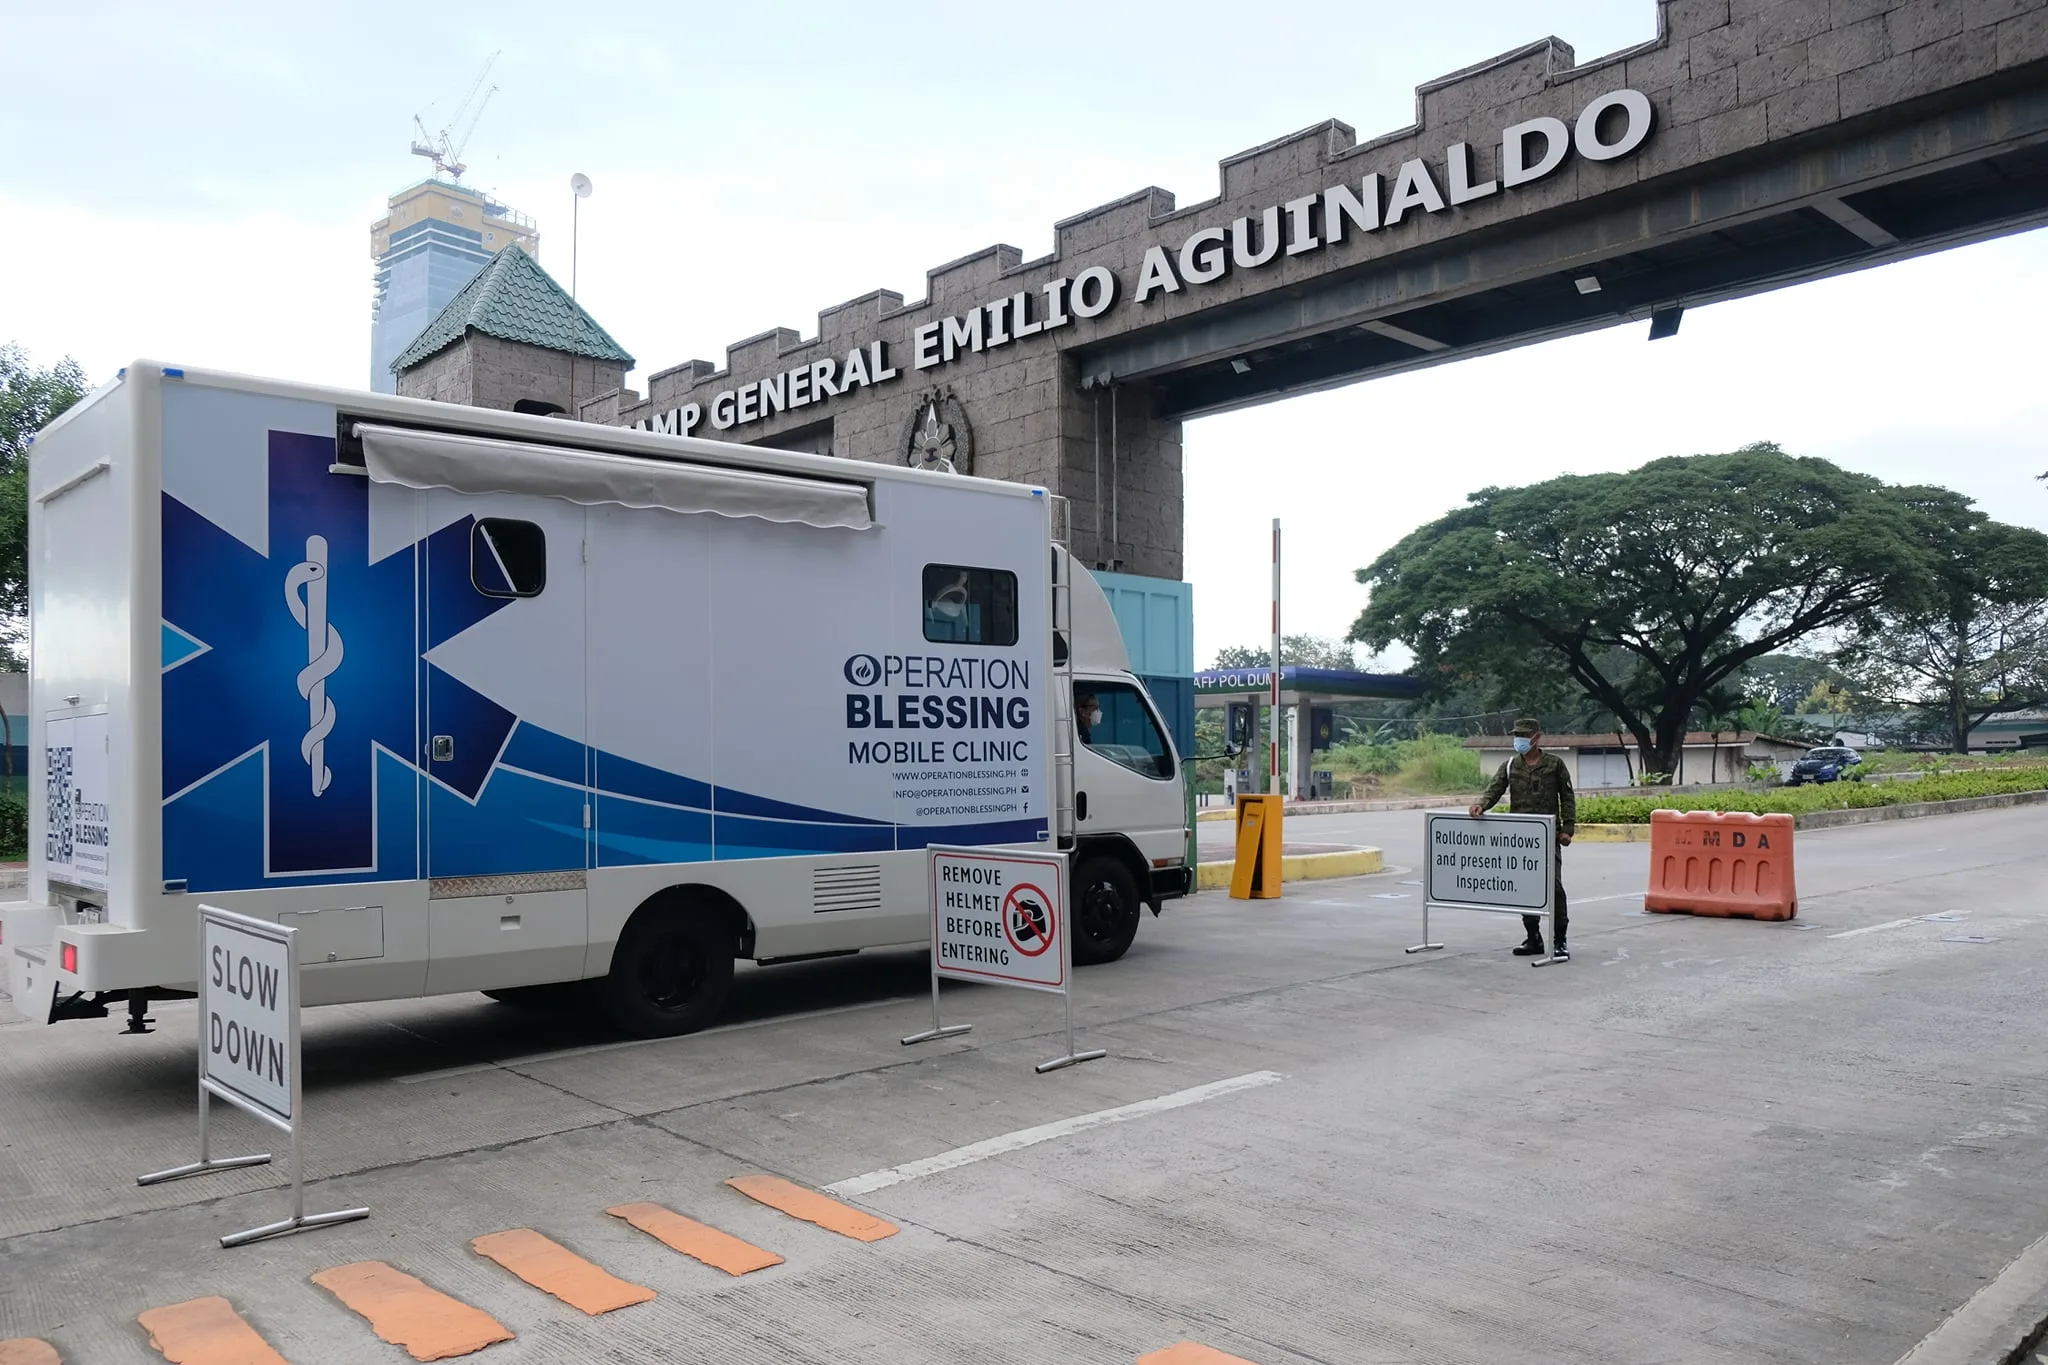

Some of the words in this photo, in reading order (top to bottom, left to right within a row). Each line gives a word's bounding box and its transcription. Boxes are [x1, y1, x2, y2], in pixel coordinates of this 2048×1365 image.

[623, 402, 701, 437] MP
[709, 340, 897, 430] GENERAL
[914, 266, 1114, 370] EMILIO
[1134, 89, 1652, 303] AGUINALDO
[843, 654, 1030, 690] OPERATION
[1193, 676, 1216, 689] AFP
[1219, 674, 1245, 688] POL
[846, 693, 1030, 729] BLESSING
[849, 741, 945, 764] MOBILE
[952, 740, 1029, 763] CLINIC
[892, 769, 1017, 781] WWW.OPERATIONBLESSING.PH
[893, 786, 1017, 799] INFO@OPERATIONBLESSING.PH
[916, 803, 1018, 817] @OPERATIONBLESSINGPH
[75, 823, 109, 847] BLESSING
[1435, 830, 1486, 847] Rolldown
[1490, 832, 1541, 849] windows
[1436, 852, 1456, 867] and
[1460, 854, 1502, 870] present
[1506, 855, 1518, 870] ID
[1522, 855, 1539, 871] for
[942, 865, 1002, 886] REMOVE
[1456, 874, 1518, 893] Inspection.
[946, 891, 1000, 912] HELMET
[946, 916, 1002, 938] BEFORE
[941, 941, 1009, 965] ENTERING
[212, 945, 279, 1011] SLOW
[211, 1011, 284, 1087] DOWN
